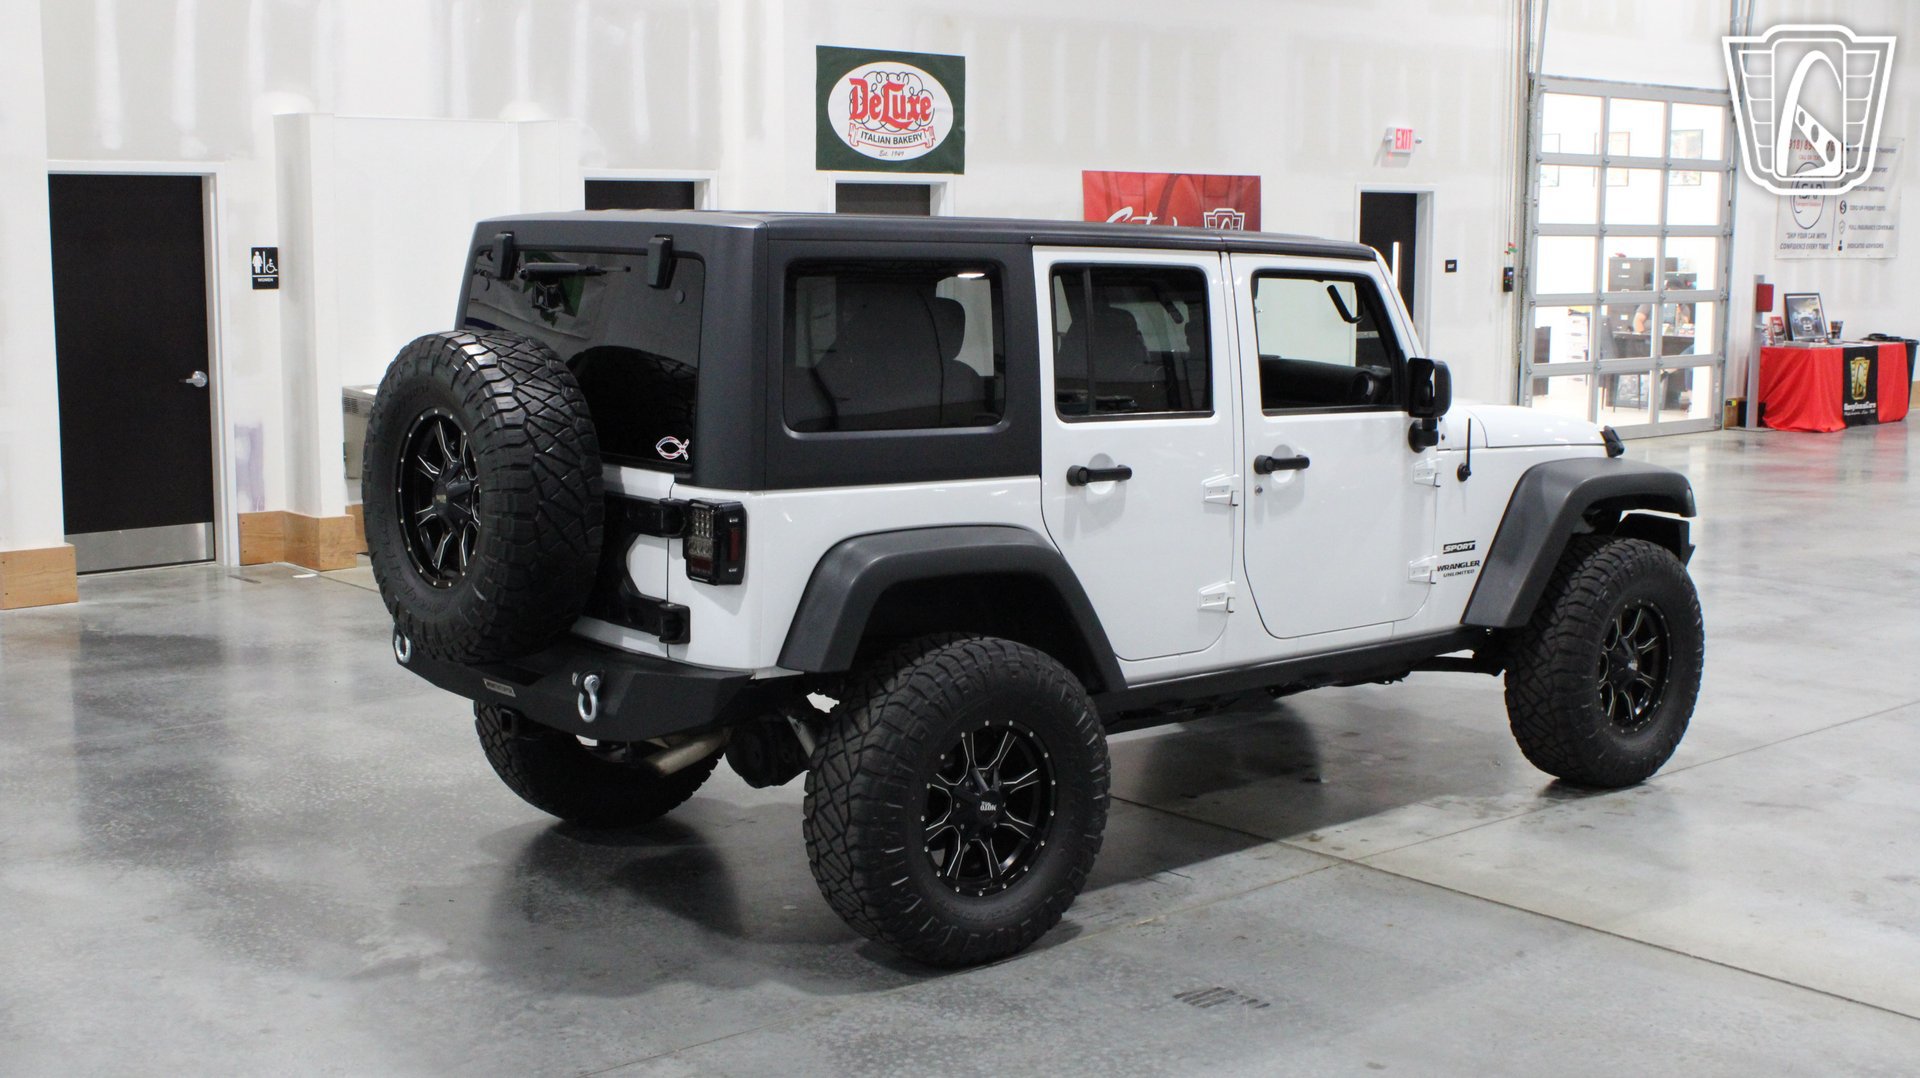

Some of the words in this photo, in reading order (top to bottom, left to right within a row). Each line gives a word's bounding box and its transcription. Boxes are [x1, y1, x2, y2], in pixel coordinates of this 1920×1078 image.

[848, 78, 932, 129] DeLuxe
[860, 131, 891, 145] ITALIAN
[893, 132, 923, 145] BAKERY
[1395, 128, 1413, 150] EXIT
[1444, 543, 1473, 553] SPORT
[1437, 560, 1480, 572] WRANGLER
[1443, 569, 1475, 578] UNLIMITED
